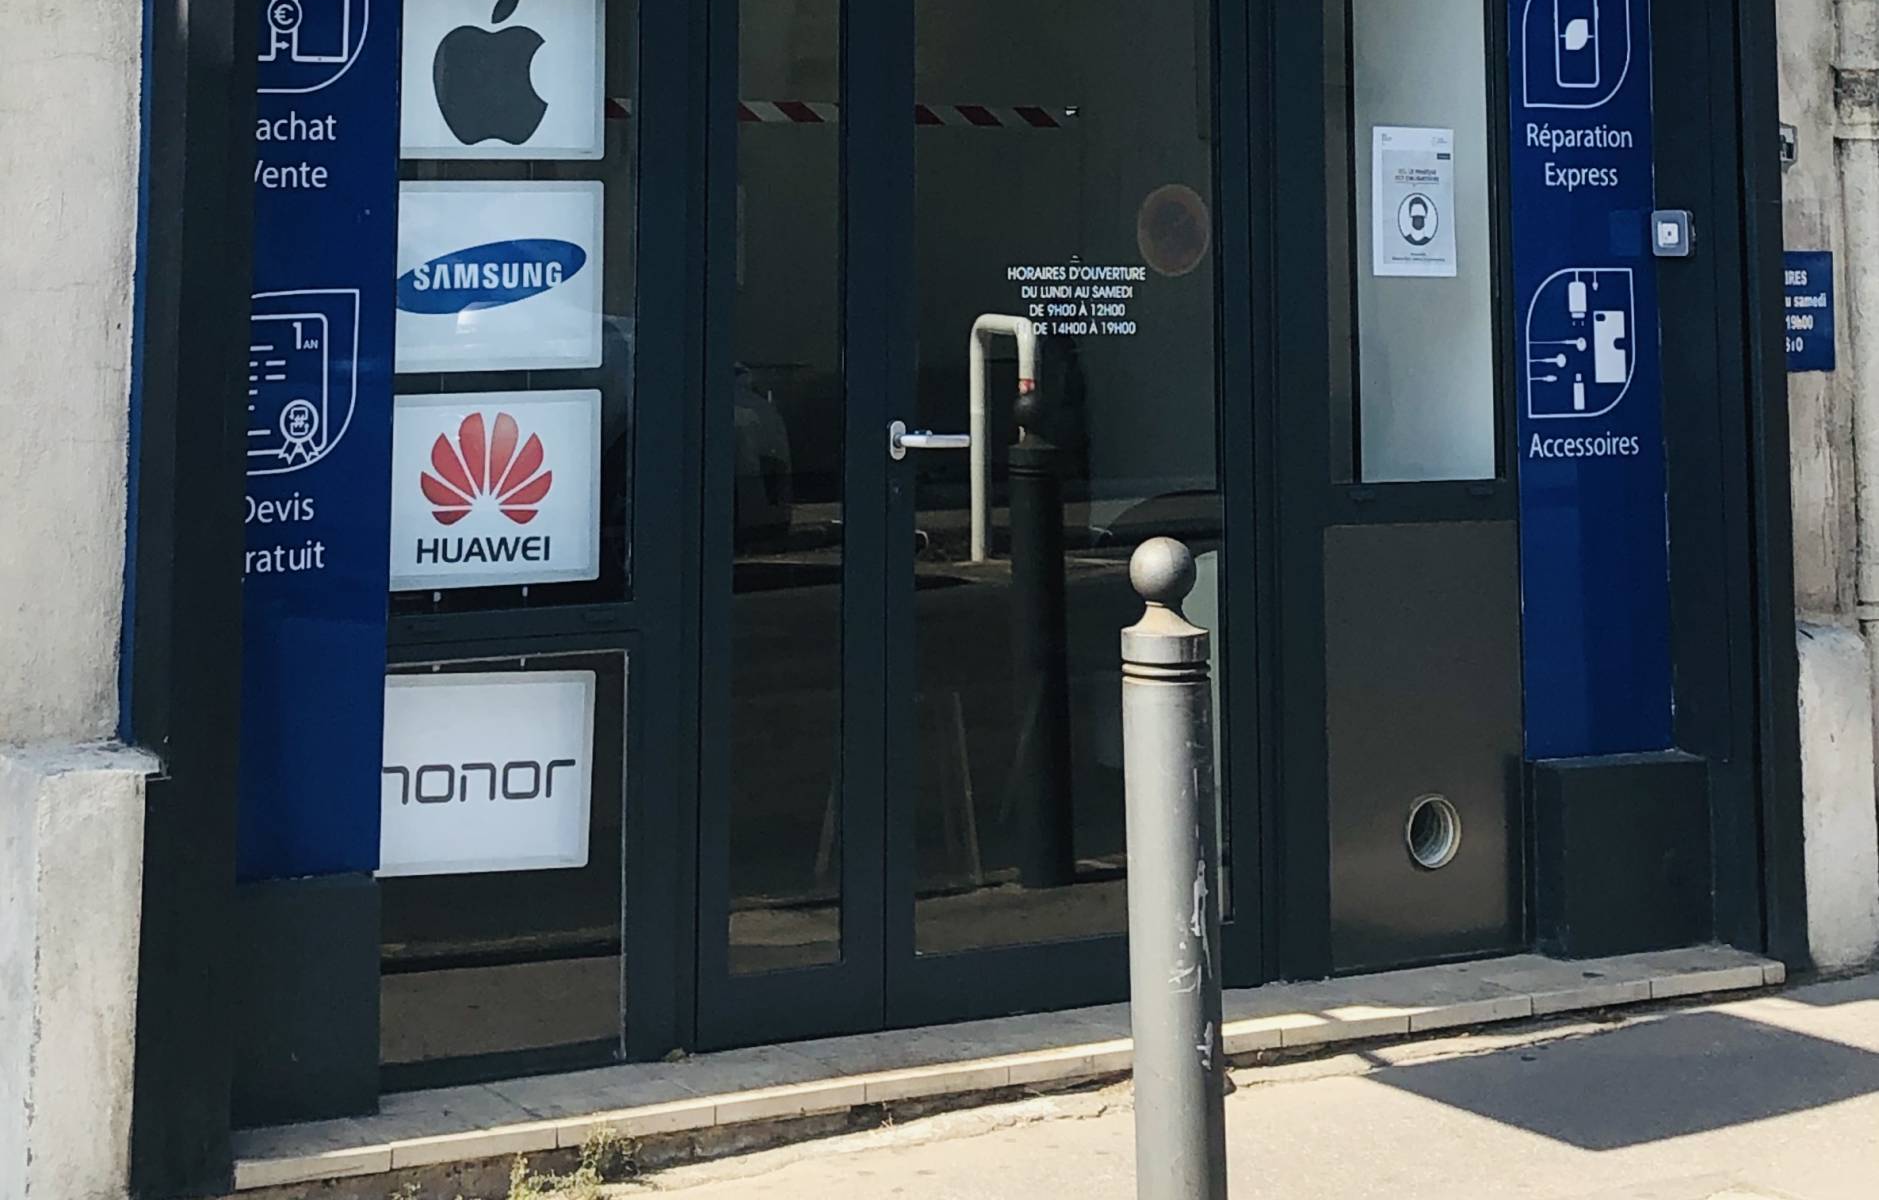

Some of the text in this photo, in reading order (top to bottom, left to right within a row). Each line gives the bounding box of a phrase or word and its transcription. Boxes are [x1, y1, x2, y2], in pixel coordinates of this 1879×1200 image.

[1526, 122, 1633, 153] Réparation
[1544, 162, 1618, 192] Express
[413, 261, 562, 291] SAMSUNG
[1008, 267, 1146, 281] HORAIRES D'OUVERTURE
[1021, 286, 1133, 299] DU LUNDI AU SAMEDI
[1793, 292, 1827, 307] samedi
[1029, 301, 1126, 317] DE 9H00 À 12H00
[1034, 319, 1137, 335] DE 14H00 À 19H00
[303, 339, 319, 350] AN
[1529, 433, 1640, 459] Accessoires
[244, 540, 325, 574] ratuit
[416, 536, 551, 565] HUAWEI
